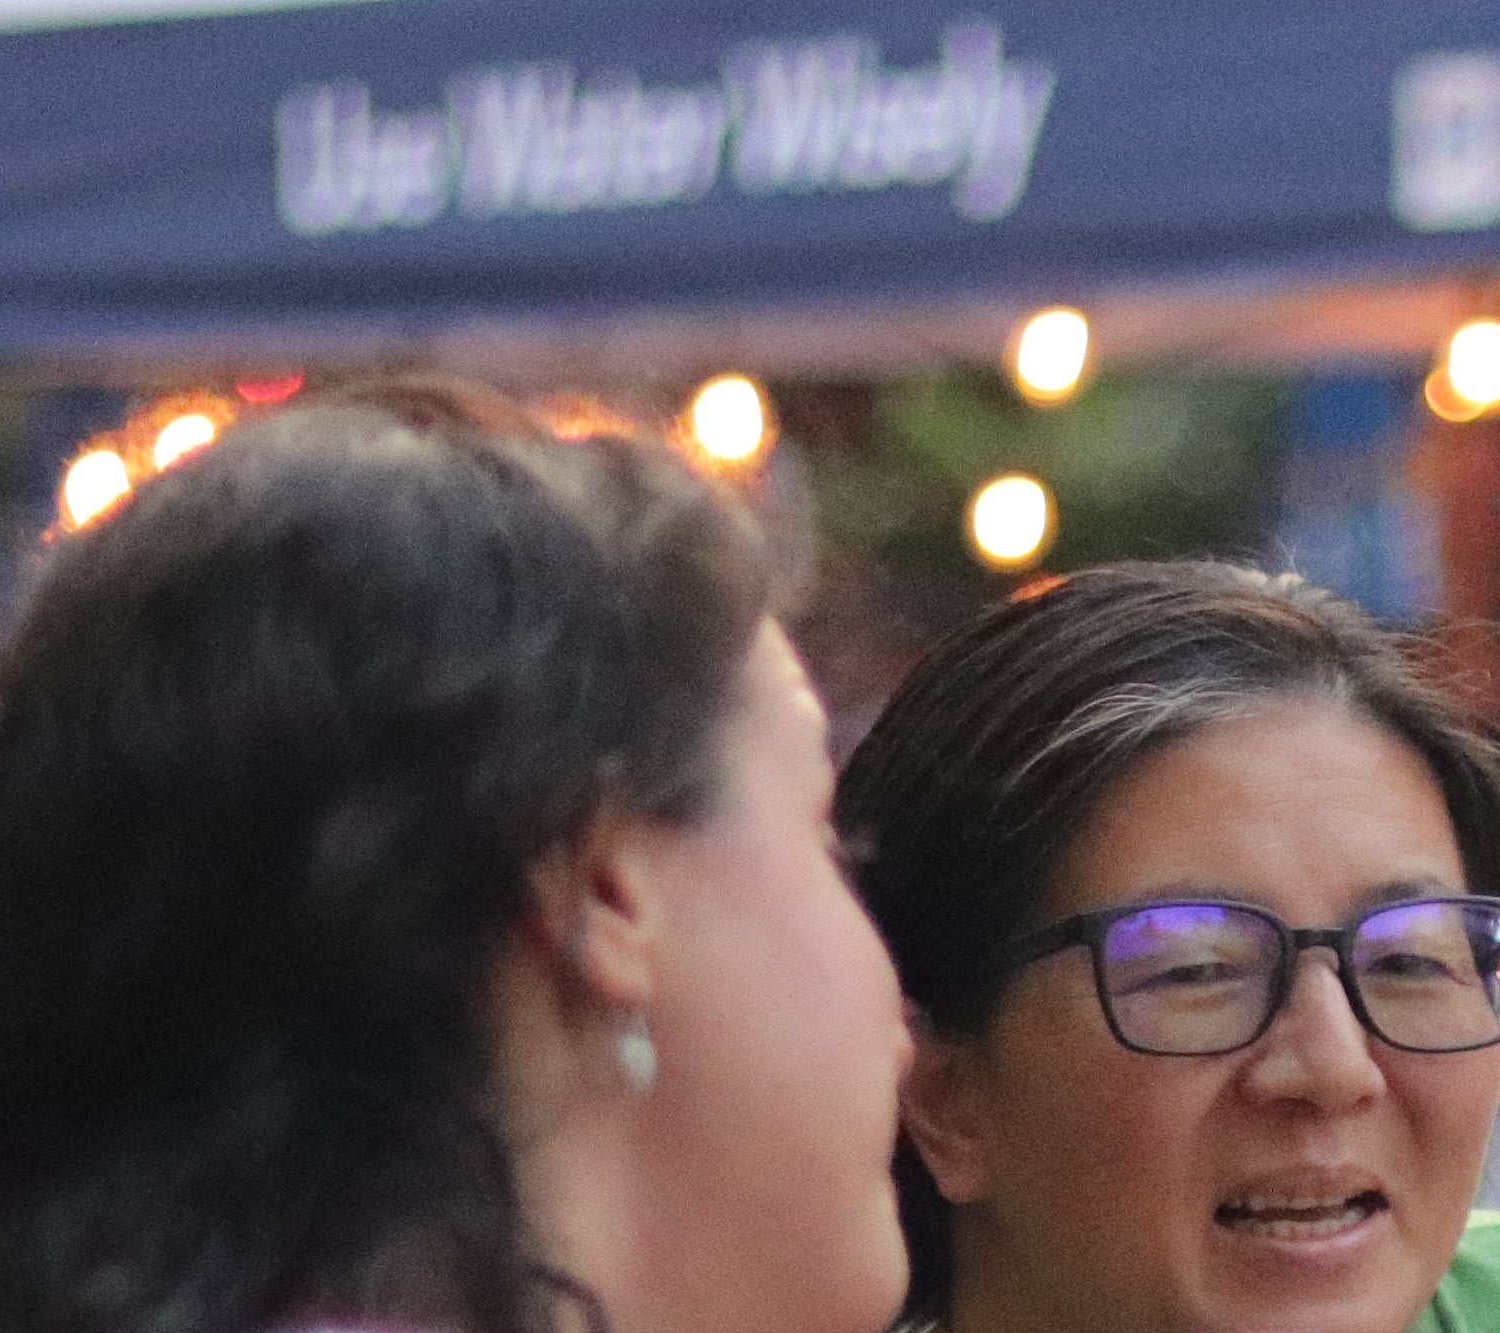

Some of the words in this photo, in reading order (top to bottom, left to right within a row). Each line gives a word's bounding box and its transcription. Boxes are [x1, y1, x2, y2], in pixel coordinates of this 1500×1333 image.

[275, 78, 452, 236] Use
[446, 60, 728, 217] Water
[722, 20, 1054, 221] Wisely
